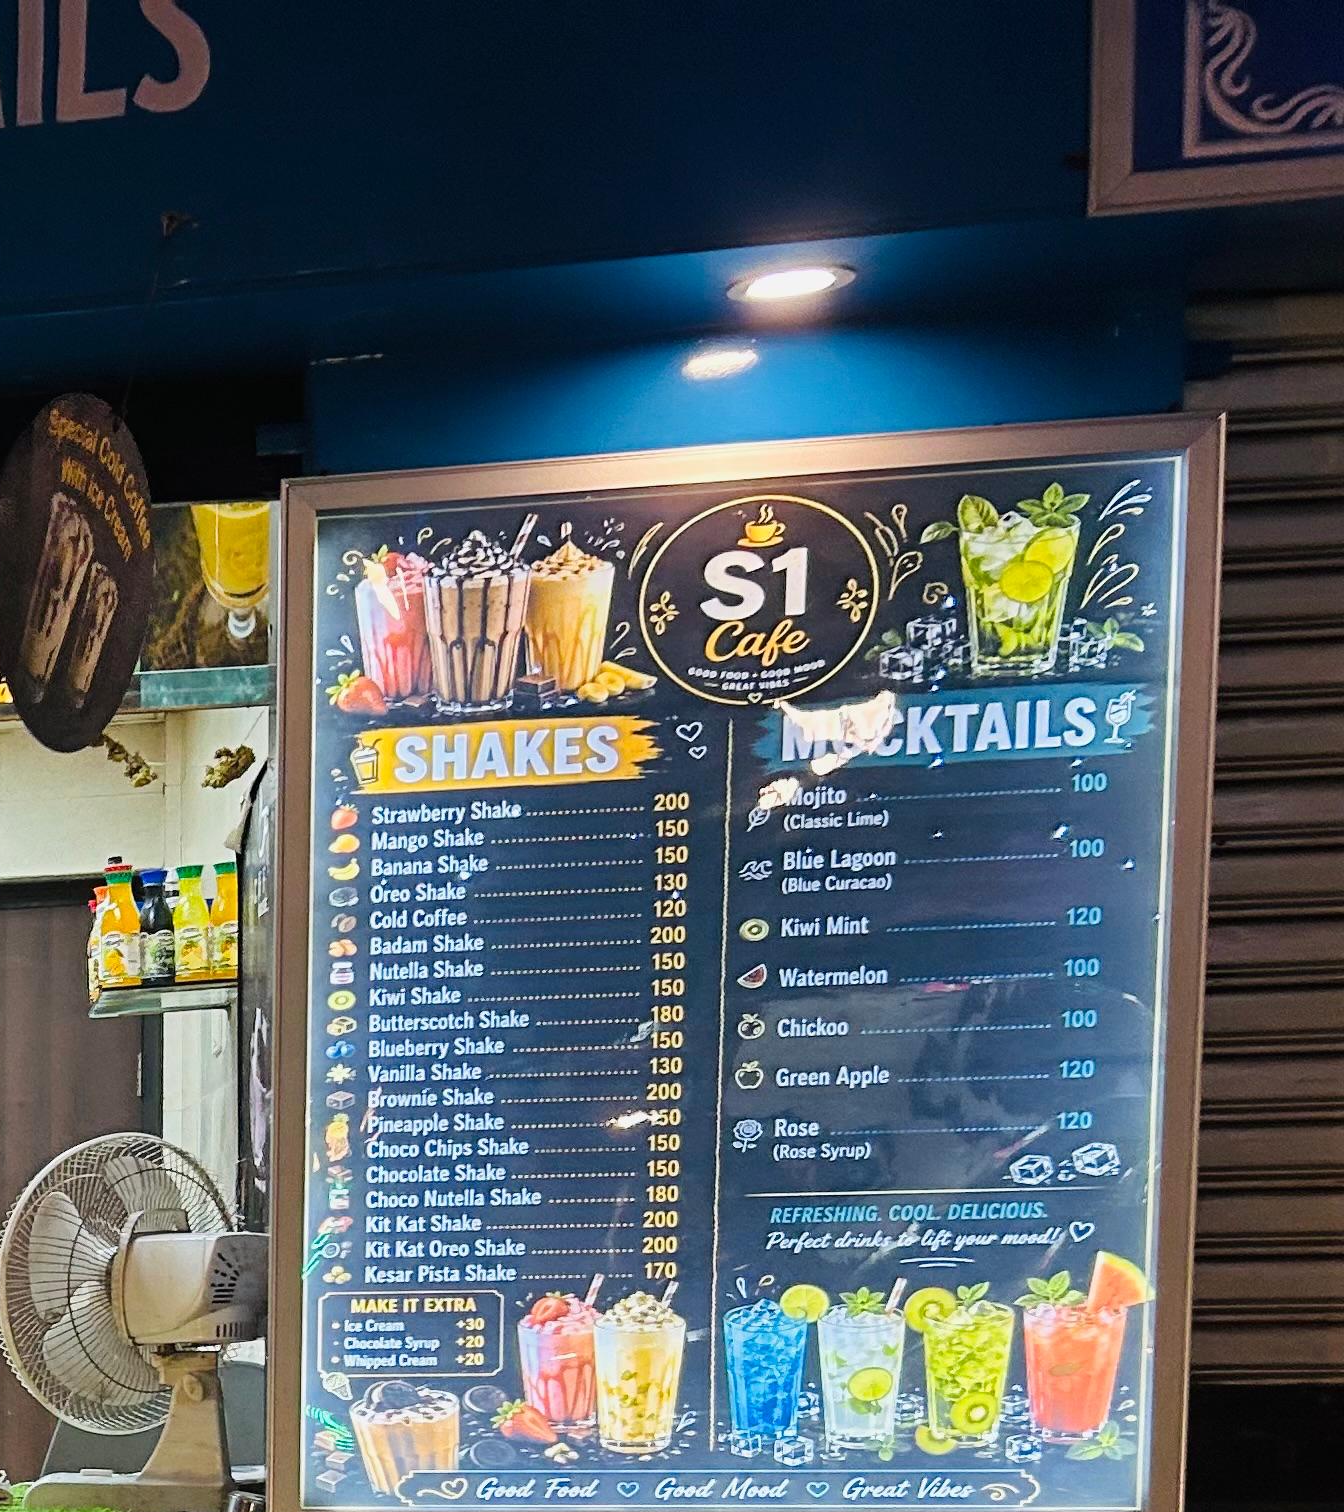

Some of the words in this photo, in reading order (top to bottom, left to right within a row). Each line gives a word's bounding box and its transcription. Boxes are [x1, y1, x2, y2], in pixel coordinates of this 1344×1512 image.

[99, 436, 125, 485] Cold
[124, 472, 151, 551] Coffee
[700, 547, 808, 621] S1
[705, 618, 811, 667] Cafe
[782, 697, 1097, 762] MKTAILS
[393, 724, 621, 784] SHAKES
[1072, 772, 1107, 792] 100
[372, 804, 465, 826] Strawberry
[470, 801, 521, 820] Shake
[653, 792, 690, 812] 200
[783, 812, 843, 832] (Classic
[847, 810, 889, 829] Lime)
[371, 832, 429, 854] Mango
[433, 828, 484, 847] Shake
[655, 819, 689, 837] 150
[371, 858, 433, 877] Banana
[437, 854, 488, 875] Shake
[655, 846, 688, 864] 150
[783, 850, 825, 871] Blue
[830, 848, 896, 871] Lagoon
[1070, 838, 1105, 858] 100
[370, 884, 410, 903] Oreo
[415, 882, 465, 900] Shake
[654, 873, 687, 891] 130
[782, 876, 821, 894] (Blue
[825, 873, 892, 893] Curacao)
[370, 911, 407, 929] Cold
[412, 908, 467, 927] Coffee
[653, 900, 687, 918] 120
[780, 918, 820, 938] Kiwi
[826, 916, 869, 936] Mint
[1066, 906, 1102, 926] 120
[370, 937, 427, 956] Badam
[433, 935, 484, 953] Shake
[650, 926, 686, 944] 200
[369, 962, 433, 981] Nutella
[437, 960, 483, 978] Shake
[651, 952, 685, 971] 150
[779, 966, 888, 988] Watermelon
[1064, 958, 1100, 977] 100
[369, 987, 407, 1006] Kiwi
[412, 986, 461, 1004] Shake
[651, 978, 685, 997] 150
[369, 1013, 474, 1032] Butterscotch
[479, 1011, 529, 1029] Shake
[650, 1005, 684, 1023] 180
[777, 1017, 849, 1037] Chickoo
[1061, 1009, 1097, 1028] 100
[368, 1040, 452, 1060] Blueberry
[456, 1036, 504, 1055] Shake
[650, 1031, 683, 1050] 150
[368, 1065, 426, 1083] Vanilla
[430, 1063, 481, 1081] Shake
[649, 1057, 683, 1075] 130
[776, 1067, 830, 1087] Green
[836, 1065, 889, 1088] Apple
[1059, 1060, 1095, 1079] 120
[368, 1088, 438, 1109] Brownie
[442, 1088, 494, 1106] Shake
[646, 1082, 682, 1101] 200
[368, 1114, 449, 1135] Pineapple
[454, 1114, 504, 1131] Shake
[774, 1119, 820, 1137] Rose
[1056, 1111, 1093, 1130] 120
[367, 1140, 419, 1158] Choco
[424, 1138, 474, 1158] Chips
[478, 1137, 529, 1156] Shake
[647, 1133, 681, 1151] 150
[773, 1144, 816, 1161] (Rose
[821, 1142, 871, 1160] Syrup)
[366, 1165, 450, 1184] Chocolate
[455, 1164, 506, 1181] Shake
[646, 1159, 679, 1177] 150
[366, 1191, 419, 1209] Choco
[424, 1189, 485, 1207] Nutella
[490, 1187, 542, 1206] Shake
[646, 1185, 679, 1203] 180
[366, 1216, 391, 1233] Kit
[396, 1215, 426, 1233] Kat
[430, 1214, 482, 1232] Shake
[643, 1210, 678, 1229] 200
[770, 1204, 882, 1224] REFRESHING.
[889, 1204, 941, 1221] COOL.
[947, 1201, 1048, 1220] DELICIOUS.
[365, 1241, 391, 1259] Kit
[395, 1240, 426, 1258] Kat
[430, 1239, 470, 1257] Oreo
[474, 1238, 526, 1256] Shake
[642, 1236, 677, 1254] 200
[765, 1231, 829, 1253] Perfect
[834, 1229, 890, 1248] drinks
[921, 1227, 950, 1248] lift
[953, 1231, 997, 1252] your
[1001, 1226, 1060, 1246] mood!
[364, 1265, 414, 1283] Kesar
[418, 1264, 460, 1282] Pista
[465, 1263, 517, 1281] Shake
[644, 1261, 677, 1279] 170
[350, 1299, 398, 1314] MAKE
[403, 1299, 420, 1312] IT
[424, 1297, 477, 1312] EXTRA
[476, 1477, 535, 1500] Good
[544, 1479, 599, 1498] Food
[654, 1476, 714, 1499] Good
[722, 1478, 790, 1499] Mood
[843, 1478, 910, 1499] Great
[917, 1478, 975, 1499] Vibes
